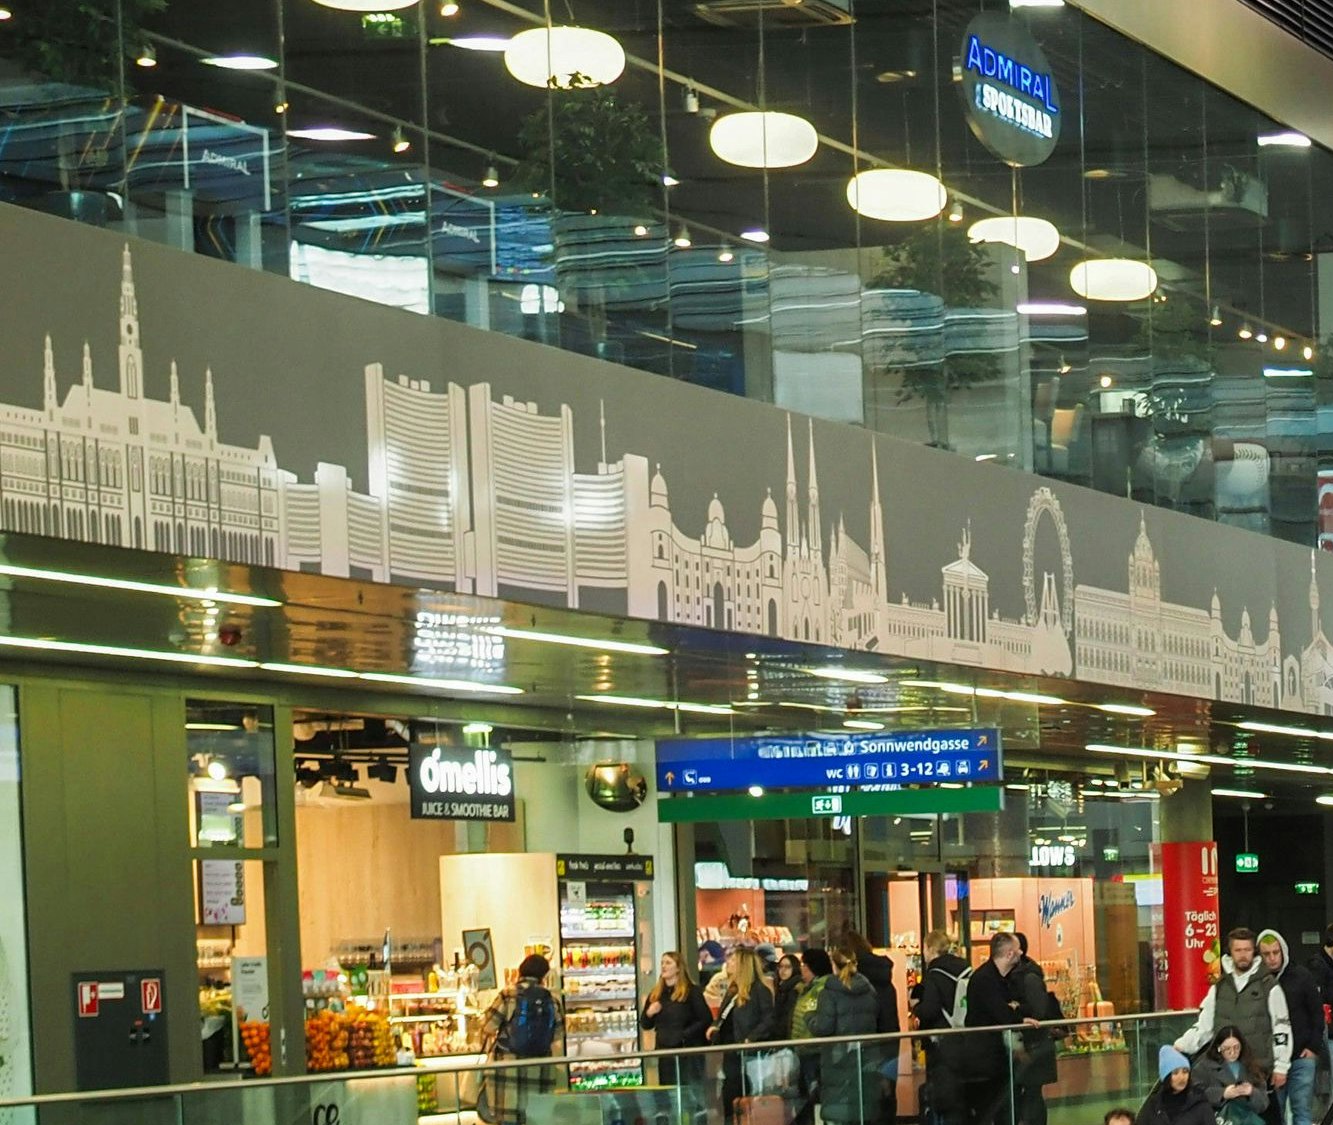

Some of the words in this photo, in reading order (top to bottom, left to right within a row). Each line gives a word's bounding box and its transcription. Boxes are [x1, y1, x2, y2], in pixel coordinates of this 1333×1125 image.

[968, 37, 1057, 112] ADMIRAL
[982, 83, 1053, 138] SPORTSBAR
[861, 737, 970, 756] Sonnwendgasse
[900, 761, 934, 777] 3-12
[422, 801, 443, 817] JUICE
[451, 802, 492, 818] SMOOTHIE
[493, 803, 509, 818] BAR
[1184, 939, 1205, 949] Uhr
